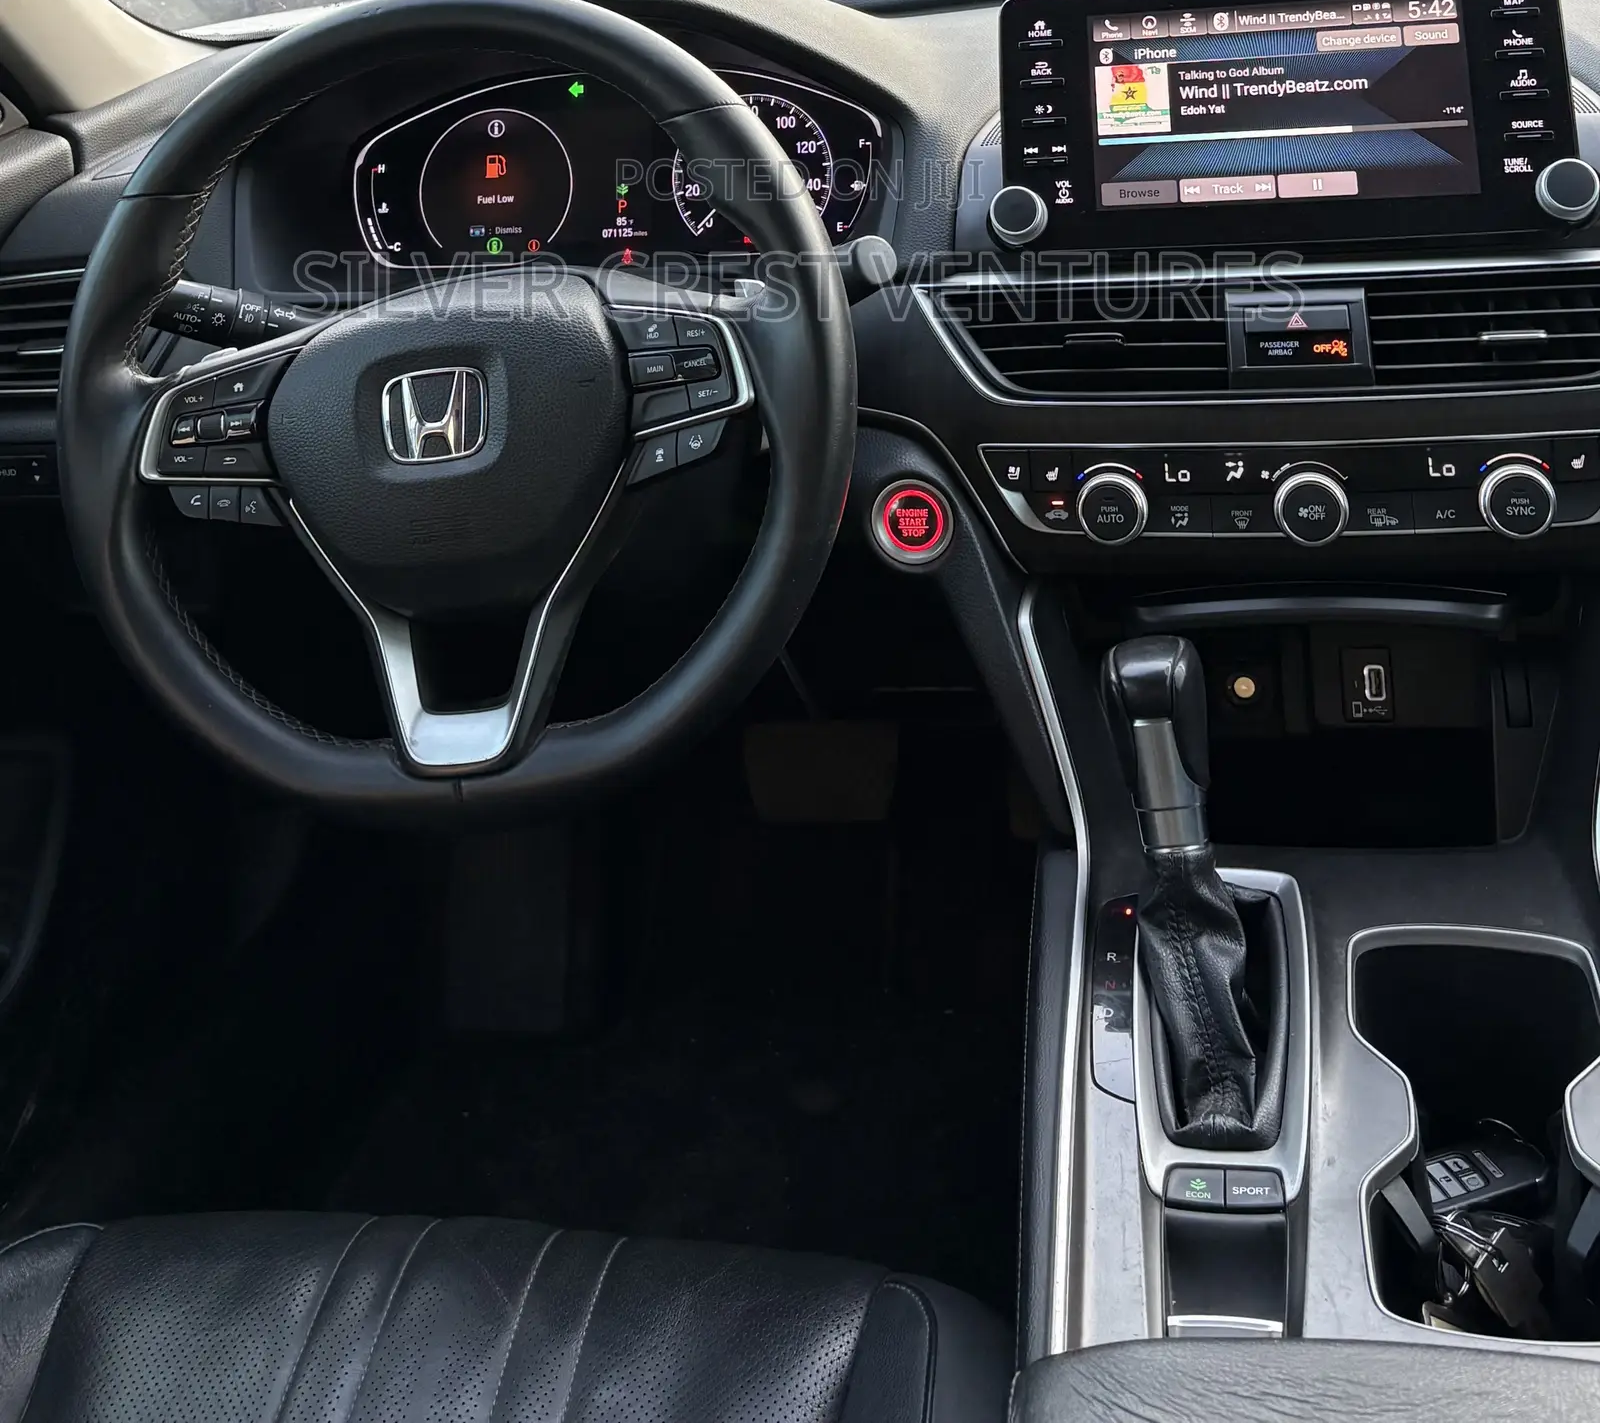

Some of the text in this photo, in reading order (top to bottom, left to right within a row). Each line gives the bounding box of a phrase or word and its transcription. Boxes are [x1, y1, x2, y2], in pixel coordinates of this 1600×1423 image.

[1408, 0, 1456, 18] 5:42
[1239, 13, 1267, 25] Wind
[1028, 29, 1052, 38] HOME
[1101, 31, 1123, 39] Phone
[1415, 30, 1448, 40] Sound
[1322, 33, 1397, 48] Change device
[1503, 38, 1534, 46] PHONE
[1134, 47, 1177, 60] iPhone
[1031, 68, 1052, 76] BACK
[1179, 65, 1285, 81] Talking to God Album
[1179, 84, 1218, 100] Wind
[1234, 77, 1369, 98] TrendyBeatz.com
[1510, 79, 1537, 88] AUDIO
[1180, 104, 1225, 116] Edoh Yat
[776, 116, 796, 129] 100
[1511, 120, 1543, 129] SOURCE
[796, 140, 816, 154] 120
[859, 139, 866, 149] F
[1503, 157, 1528, 166] TUNE/
[378, 164, 386, 174] H
[1504, 165, 1533, 174] SCROLL
[1055, 180, 1072, 188] VOL
[1212, 183, 1244, 195] Track
[685, 184, 700, 197] 20
[1119, 188, 1160, 199] Browse
[477, 194, 515, 204] Fuel Low
[618, 200, 628, 214] P
[616, 217, 628, 226] 85
[837, 222, 844, 231] E
[495, 226, 522, 235] Dismiss
[602, 228, 633, 238] 071125
[393, 242, 402, 252] C
[245, 303, 262, 313] OFF
[173, 312, 197, 323] AUTO
[646, 331, 660, 339] HUD
[1259, 340, 1300, 349] PASSENGER
[1313, 343, 1331, 353] OFF
[1267, 348, 1293, 356] AIRBAG
[683, 358, 706, 368] CANCEL
[646, 365, 664, 374] MAIN
[1428, 456, 1456, 477] Lo
[1164, 462, 1191, 482] Lo
[896, 508, 929, 517] ENGINE
[1309, 505, 1326, 514] ON/
[1436, 509, 1456, 519] A/C
[1506, 506, 1536, 516] SYNC
[1097, 514, 1125, 523] AUTO
[1309, 512, 1326, 521] OFF
[899, 518, 927, 526] START
[902, 528, 925, 537] STOP
[1106, 952, 1117, 961] R
[1105, 980, 1116, 989] N
[1103, 1007, 1114, 1018] D
[1185, 1190, 1211, 1199] ECON
[1232, 1186, 1271, 1195] SPORT
